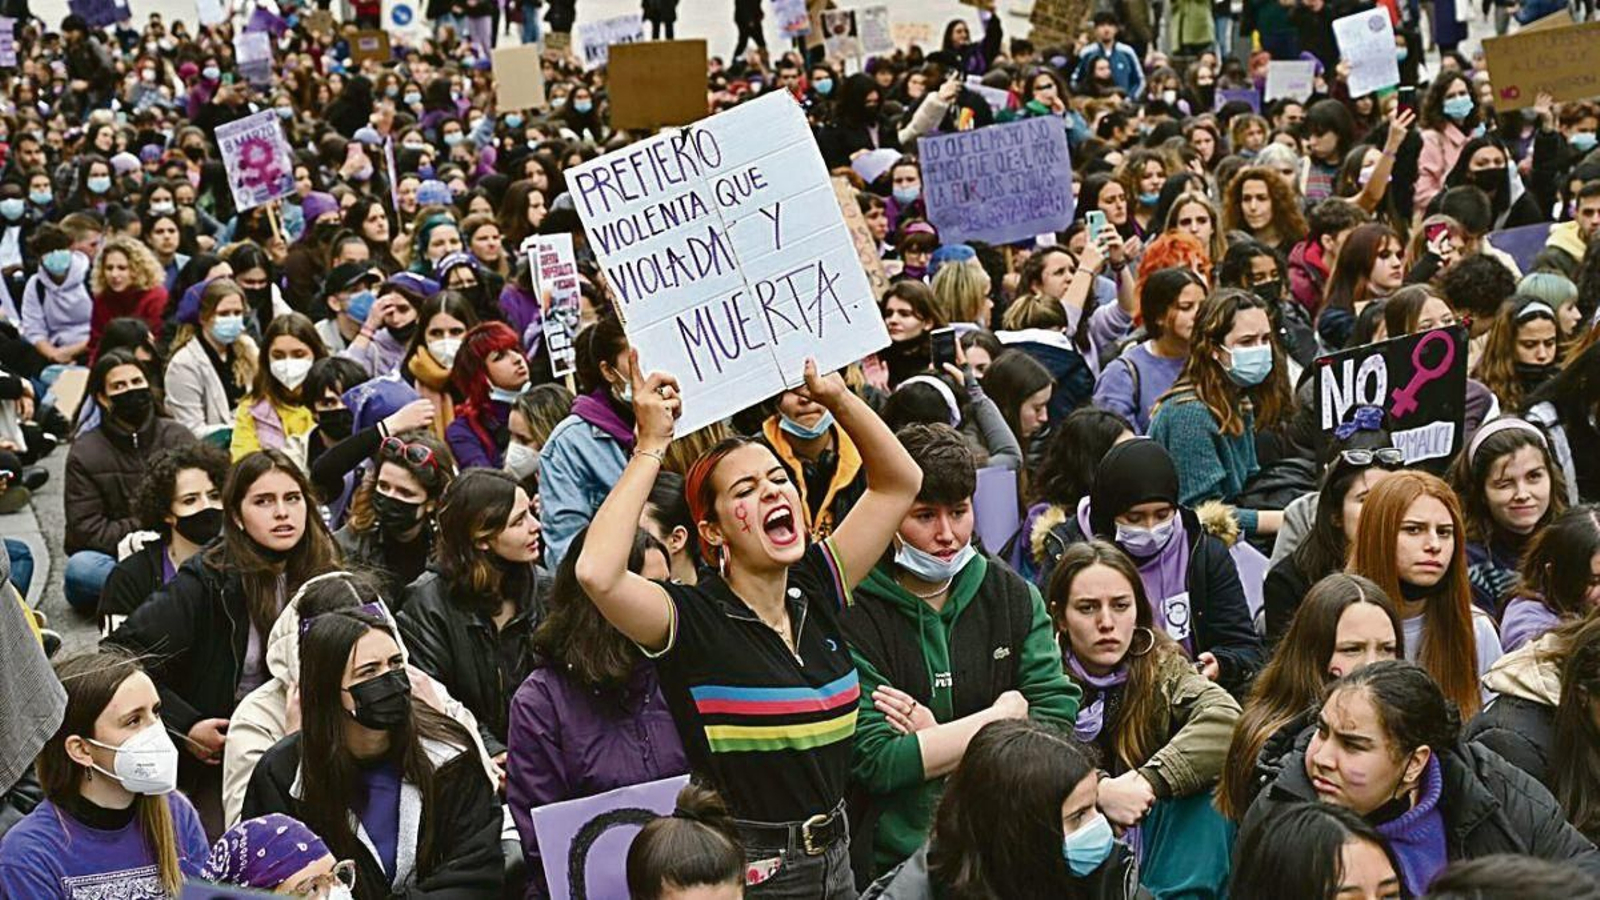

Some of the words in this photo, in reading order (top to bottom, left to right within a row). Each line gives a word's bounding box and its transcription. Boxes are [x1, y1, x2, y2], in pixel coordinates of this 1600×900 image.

[223, 140, 233, 153] 8
[234, 124, 275, 146] MARZO
[575, 128, 722, 217] PREFIERO
[924, 140, 940, 161] LO
[1028, 119, 1050, 142] NO
[592, 191, 708, 256] VIOLENTA
[715, 166, 768, 206] QUE
[608, 222, 736, 304] VIOLADA
[759, 202, 780, 250] Y
[676, 261, 858, 382] MUERTA.
[1321, 353, 1388, 430] NO
